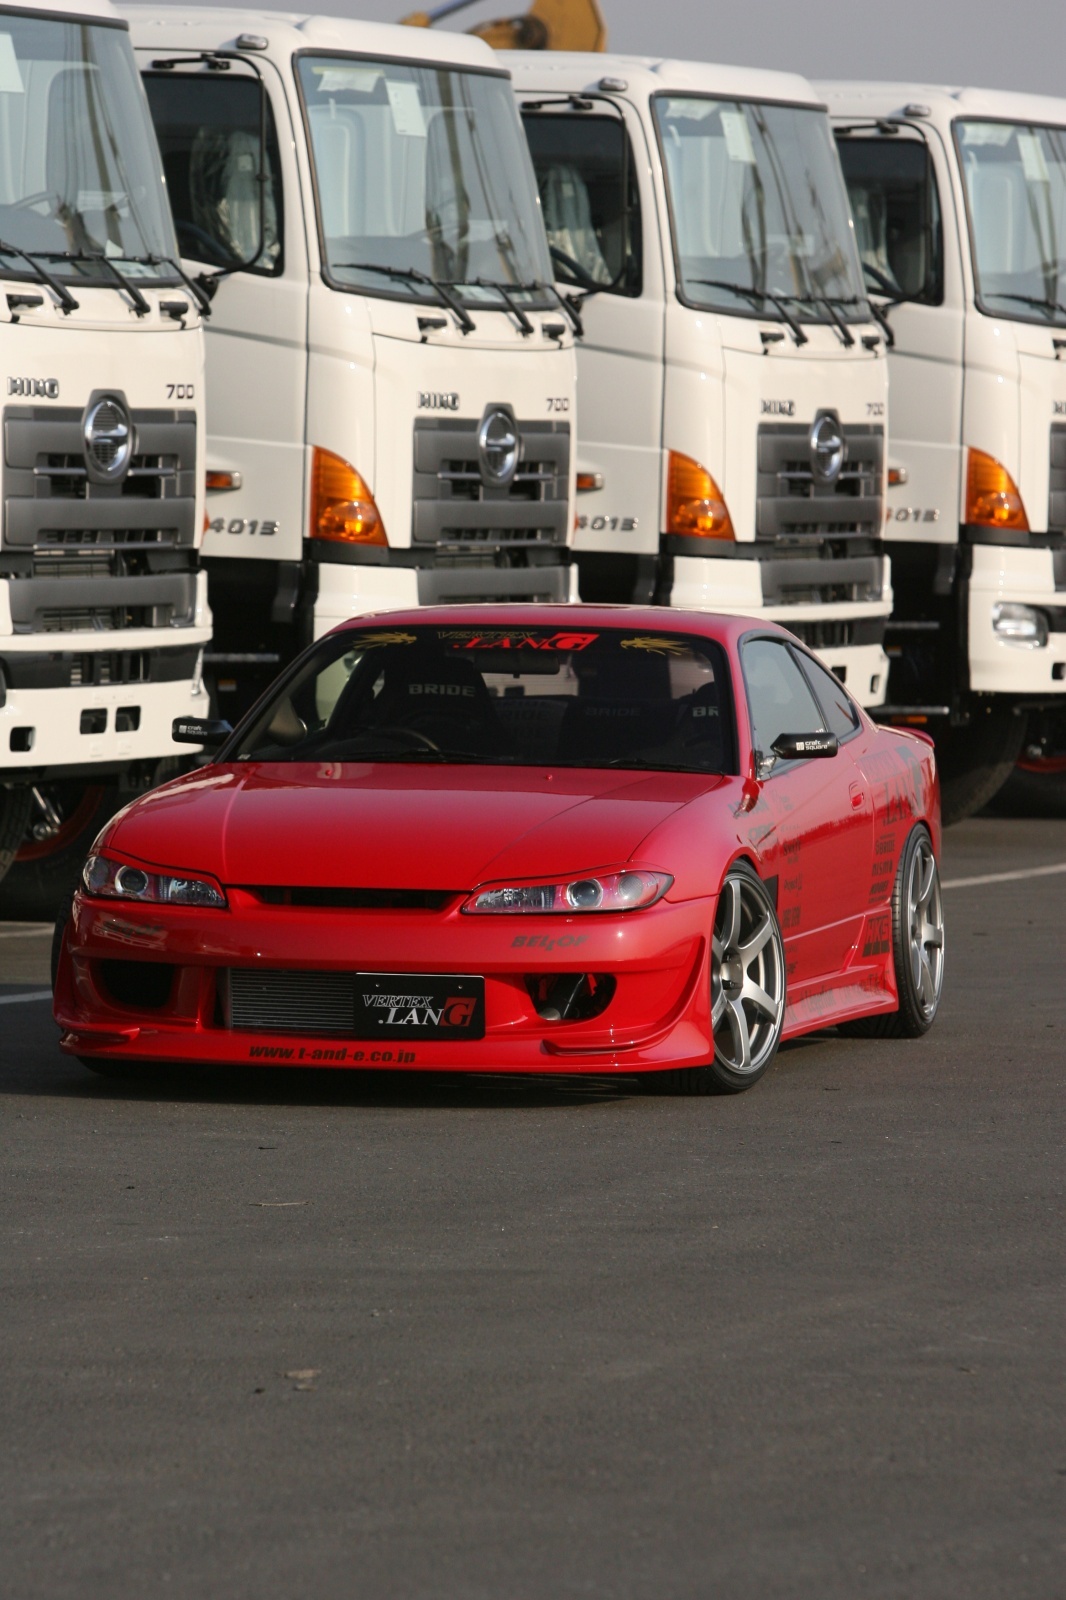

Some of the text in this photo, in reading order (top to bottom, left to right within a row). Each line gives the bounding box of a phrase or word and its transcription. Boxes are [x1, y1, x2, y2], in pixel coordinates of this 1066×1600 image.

[7, 376, 59, 399] HINO
[166, 384, 194, 399] 700
[418, 391, 459, 411] HINO
[546, 398, 569, 412] 700
[437, 631, 538, 640] VERTEX
[408, 683, 475, 697] BRIDE
[362, 994, 434, 1009] VERTEX
[249, 1045, 416, 1063] www.t-and-e.co.jp
